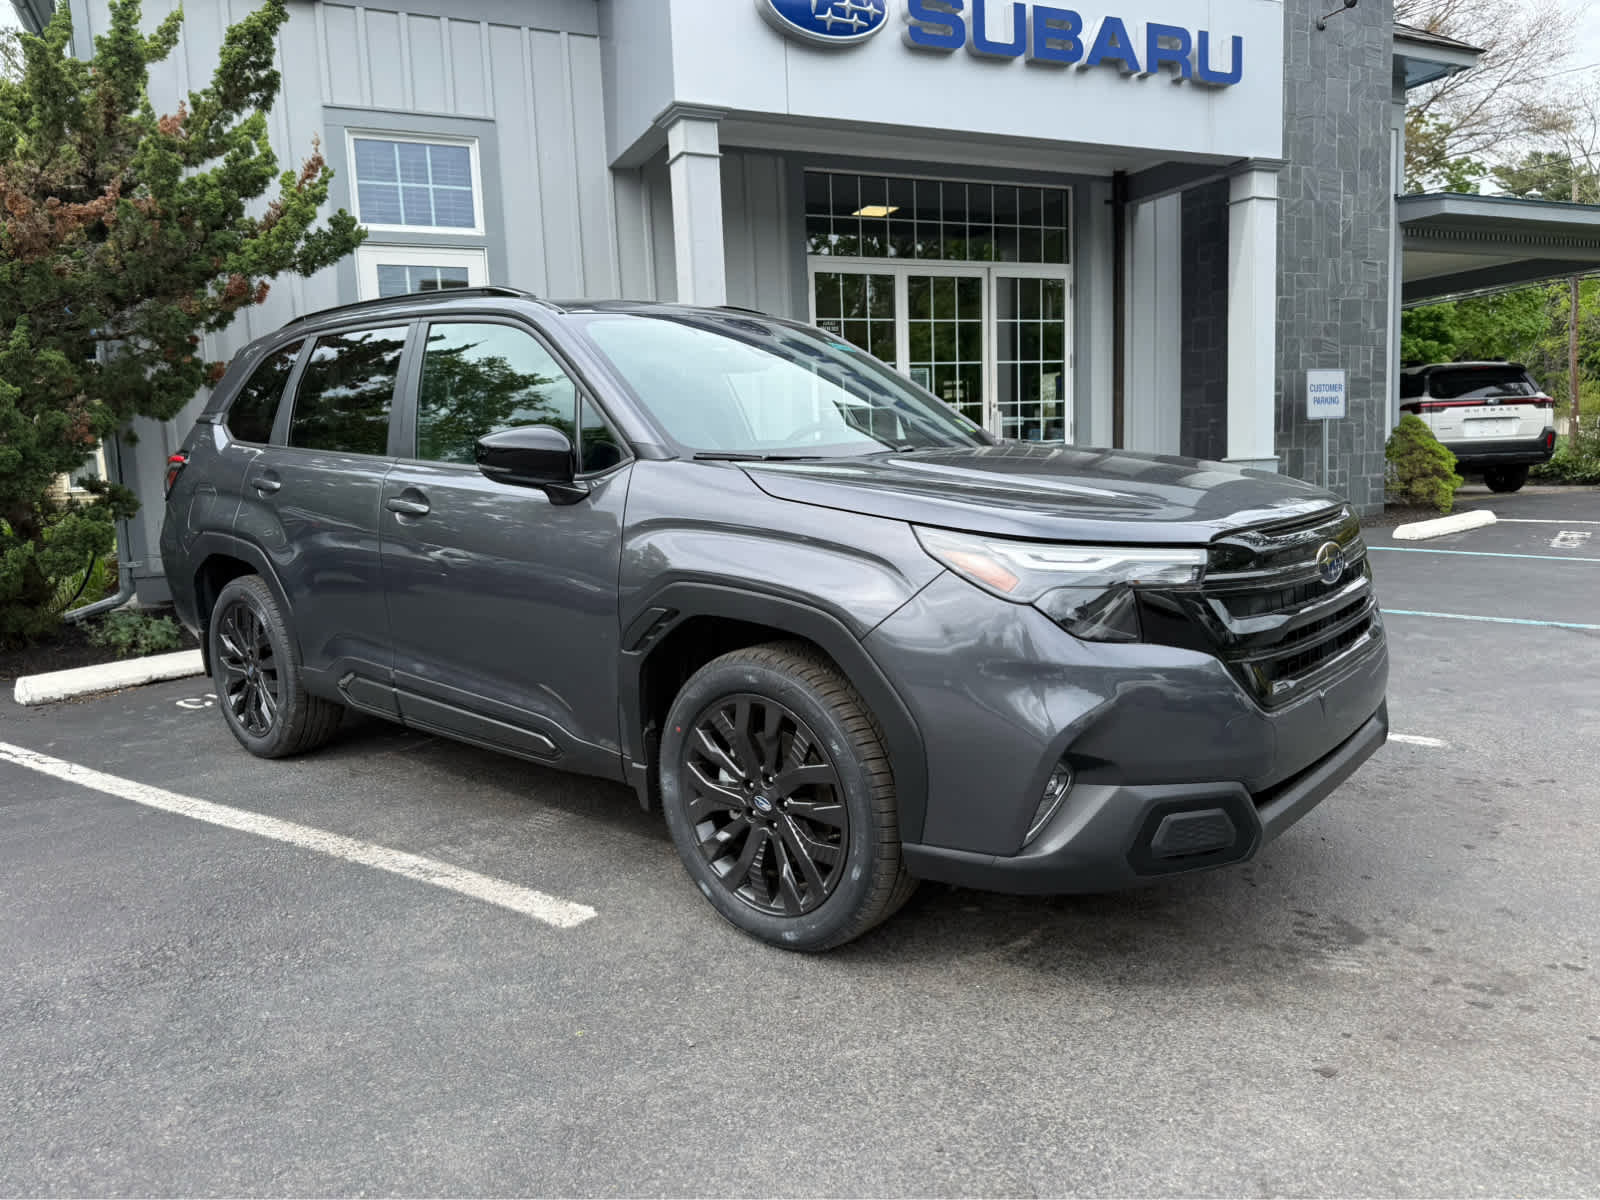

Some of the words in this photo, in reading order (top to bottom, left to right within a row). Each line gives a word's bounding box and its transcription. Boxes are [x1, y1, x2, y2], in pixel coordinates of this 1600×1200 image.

[906, 0, 1243, 86] SUBARU
[1309, 383, 1343, 393] CUSTOMER
[1313, 395, 1340, 405] PARKING
